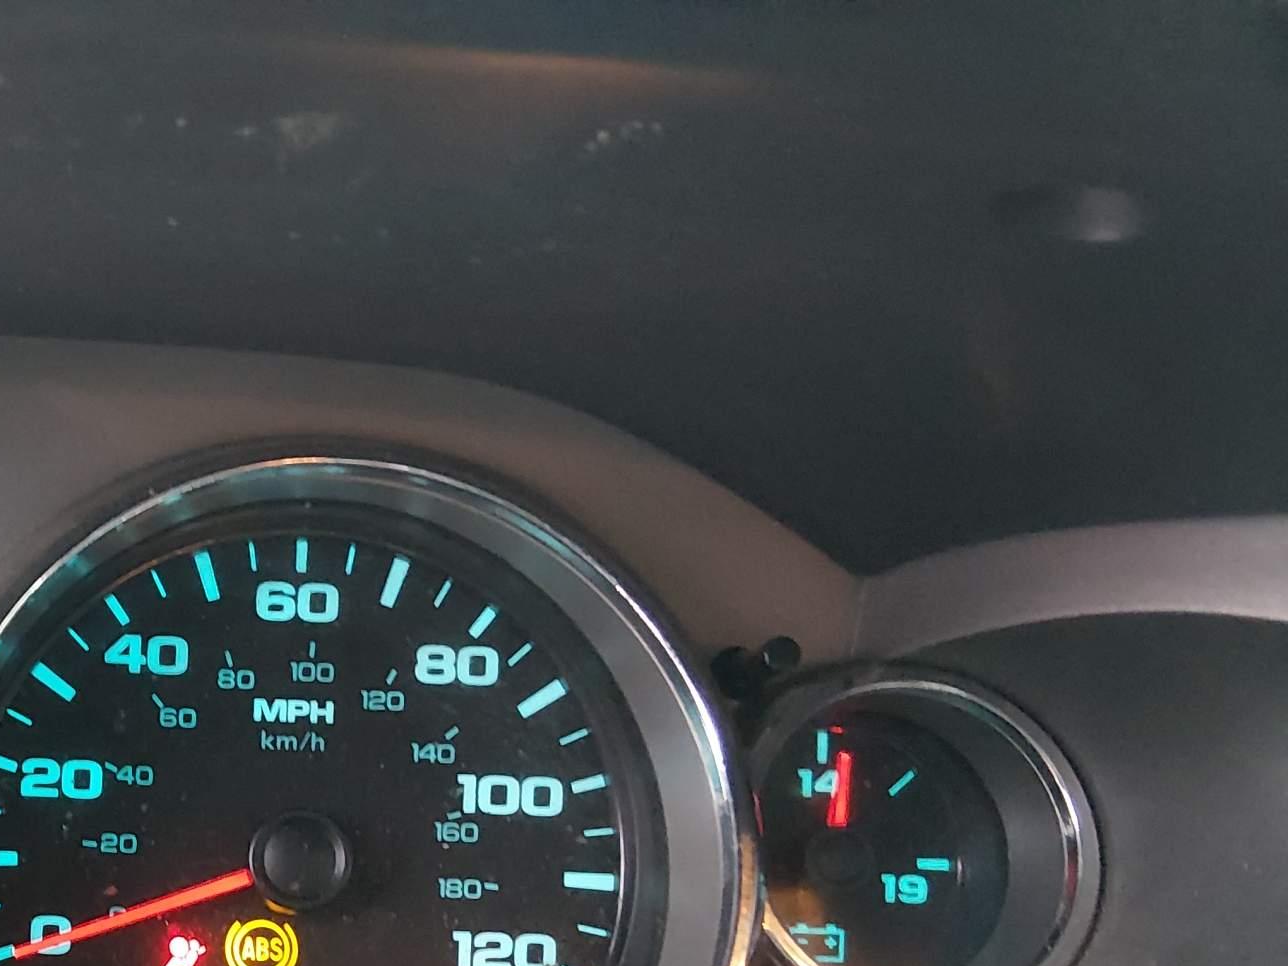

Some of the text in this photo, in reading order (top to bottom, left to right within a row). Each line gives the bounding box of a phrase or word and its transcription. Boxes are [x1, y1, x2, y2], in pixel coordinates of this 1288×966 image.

[255, 581, 340, 623] 60
[104, 633, 189, 675] 40
[414, 644, 500, 687] 80
[217, 668, 256, 690] 80
[290, 661, 335, 683] 100
[253, 697, 335, 725] MPH
[360, 689, 405, 712] 120
[159, 706, 197, 729] 60
[260, 729, 325, 752] km/h
[411, 742, 456, 764] 140
[20, 757, 104, 800] 20
[116, 765, 154, 786] 40
[797, 767, 840, 799] 14
[456, 773, 563, 818] 100
[99, 832, 138, 854] 20
[434, 821, 479, 844] 160
[438, 878, 482, 900] 180
[881, 873, 929, 905] 19
[30, 914, 72, 956] 0
[241, 936, 284, 962] ABS
